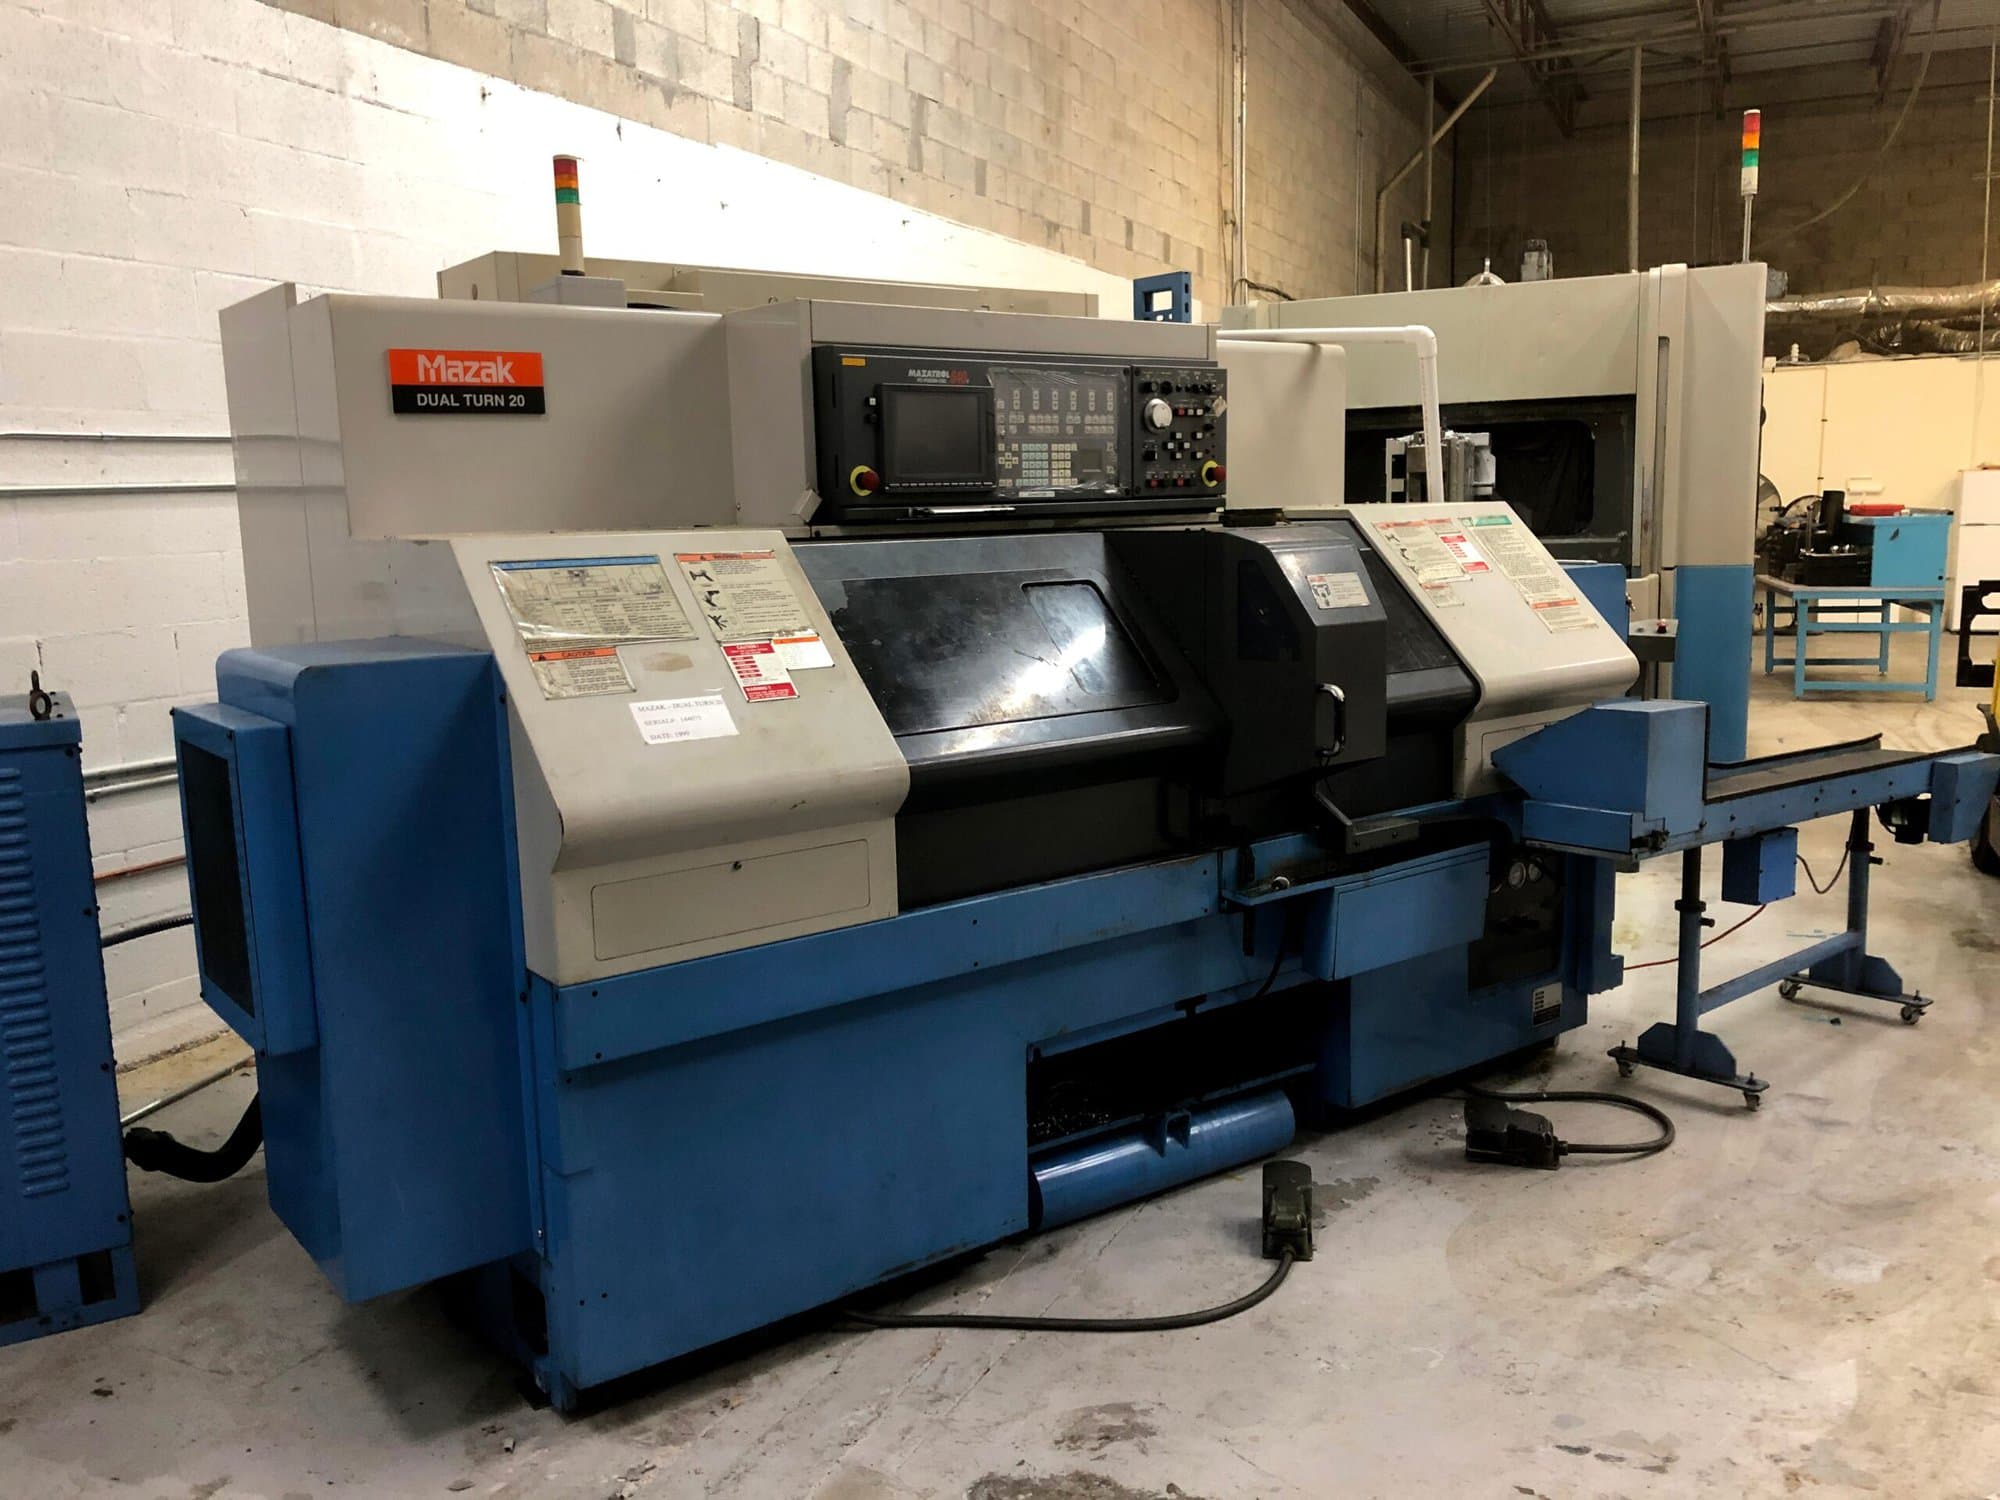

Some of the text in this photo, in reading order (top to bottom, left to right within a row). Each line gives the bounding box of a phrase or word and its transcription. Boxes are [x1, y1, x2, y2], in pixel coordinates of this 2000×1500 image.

[417, 354, 515, 384] Mazak
[417, 393, 525, 407] DUAL TURN 20
[561, 649, 596, 659] CAUTION
